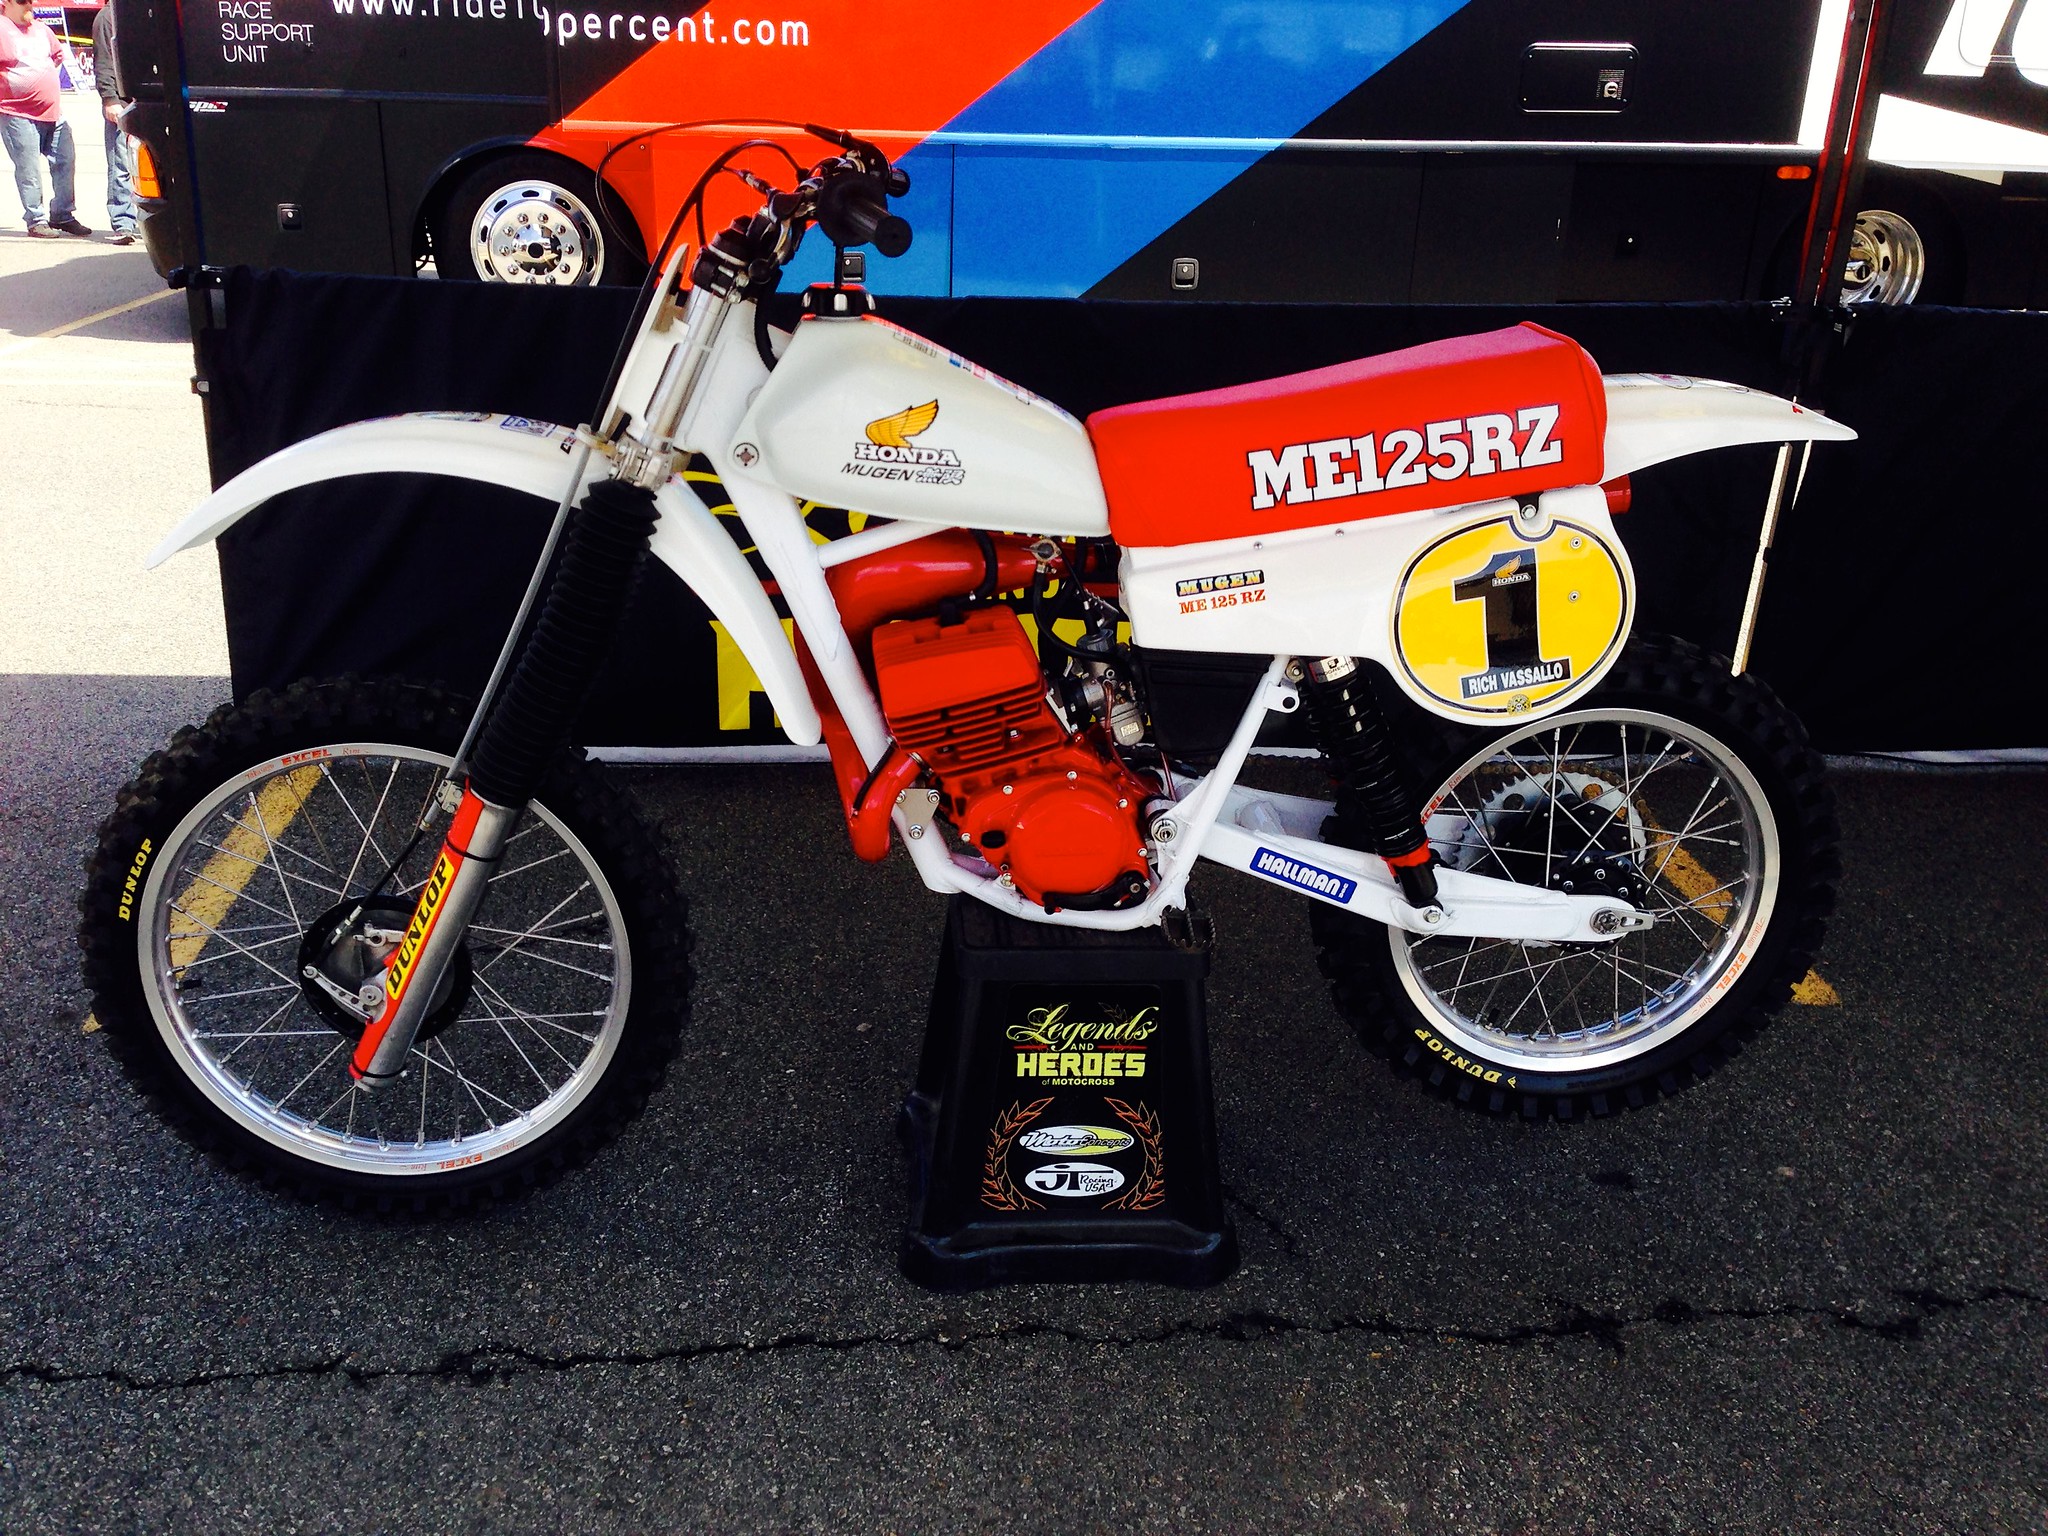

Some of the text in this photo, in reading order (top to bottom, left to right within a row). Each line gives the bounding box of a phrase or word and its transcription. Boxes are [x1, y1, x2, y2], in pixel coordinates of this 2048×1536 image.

[218, 1, 273, 19] RACE
[221, 22, 314, 41] SUPPORT
[222, 45, 268, 63] UNIT
[855, 442, 961, 467] HONDA
[1247, 403, 1563, 510] ME125RZ
[841, 463, 915, 481] MUGEN
[1178, 571, 1262, 596] MUGEN
[1491, 572, 1532, 587] HONDA
[1179, 589, 1266, 614] ME 125 RZ
[1453, 547, 1571, 698] 1
[1469, 662, 1564, 695] RICH VASSALLO
[281, 750, 332, 766] EXCEL
[119, 838, 152, 921] DUNLOP
[1257, 852, 1341, 896] HALLMAN
[389, 857, 447, 994] DUNLOP
[1716, 952, 1748, 990] EXCEL
[1006, 1003, 1160, 1051] Legends
[1070, 1043, 1095, 1051] AND
[1414, 1028, 1503, 1083] DUNLOP
[1016, 1053, 1146, 1077] HEROES
[1042, 1078, 1115, 1086] of MOTOCROSS
[436, 1153, 484, 1170] EXCEL
[1080, 1174, 1114, 1188] Racing
[1085, 1182, 1107, 1193] USA
